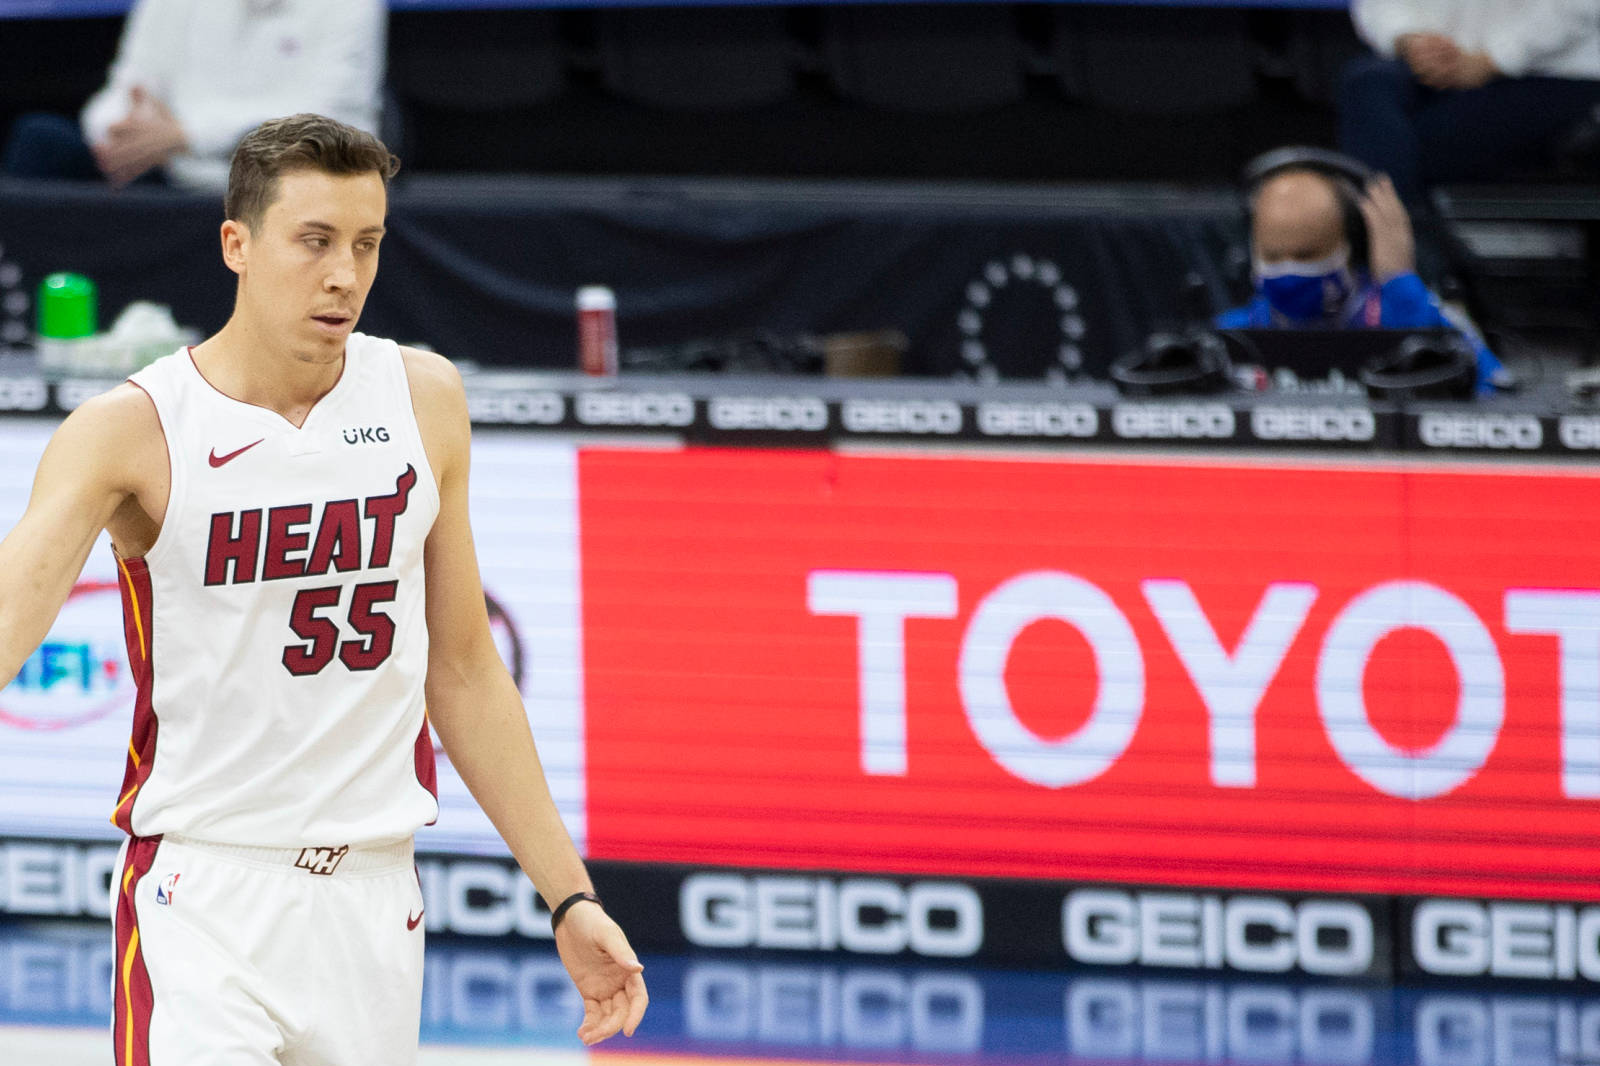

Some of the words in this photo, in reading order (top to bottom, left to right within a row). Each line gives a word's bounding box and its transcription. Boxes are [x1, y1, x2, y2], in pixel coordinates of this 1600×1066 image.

[465, 391, 565, 424] EICO
[576, 393, 695, 427] GEICO
[709, 398, 829, 432] GEICO
[842, 401, 963, 434] GEICO
[977, 404, 1099, 437] GEICO
[1112, 405, 1236, 439] GEICO
[1251, 407, 1376, 441] GEICO
[1419, 414, 1544, 450] GEICO
[204, 463, 418, 586] HEAT
[282, 580, 400, 677] 55
[807, 569, 1600, 801] TOYOT
[679, 872, 985, 958] GEICO
[1061, 888, 1375, 977] GEICO
